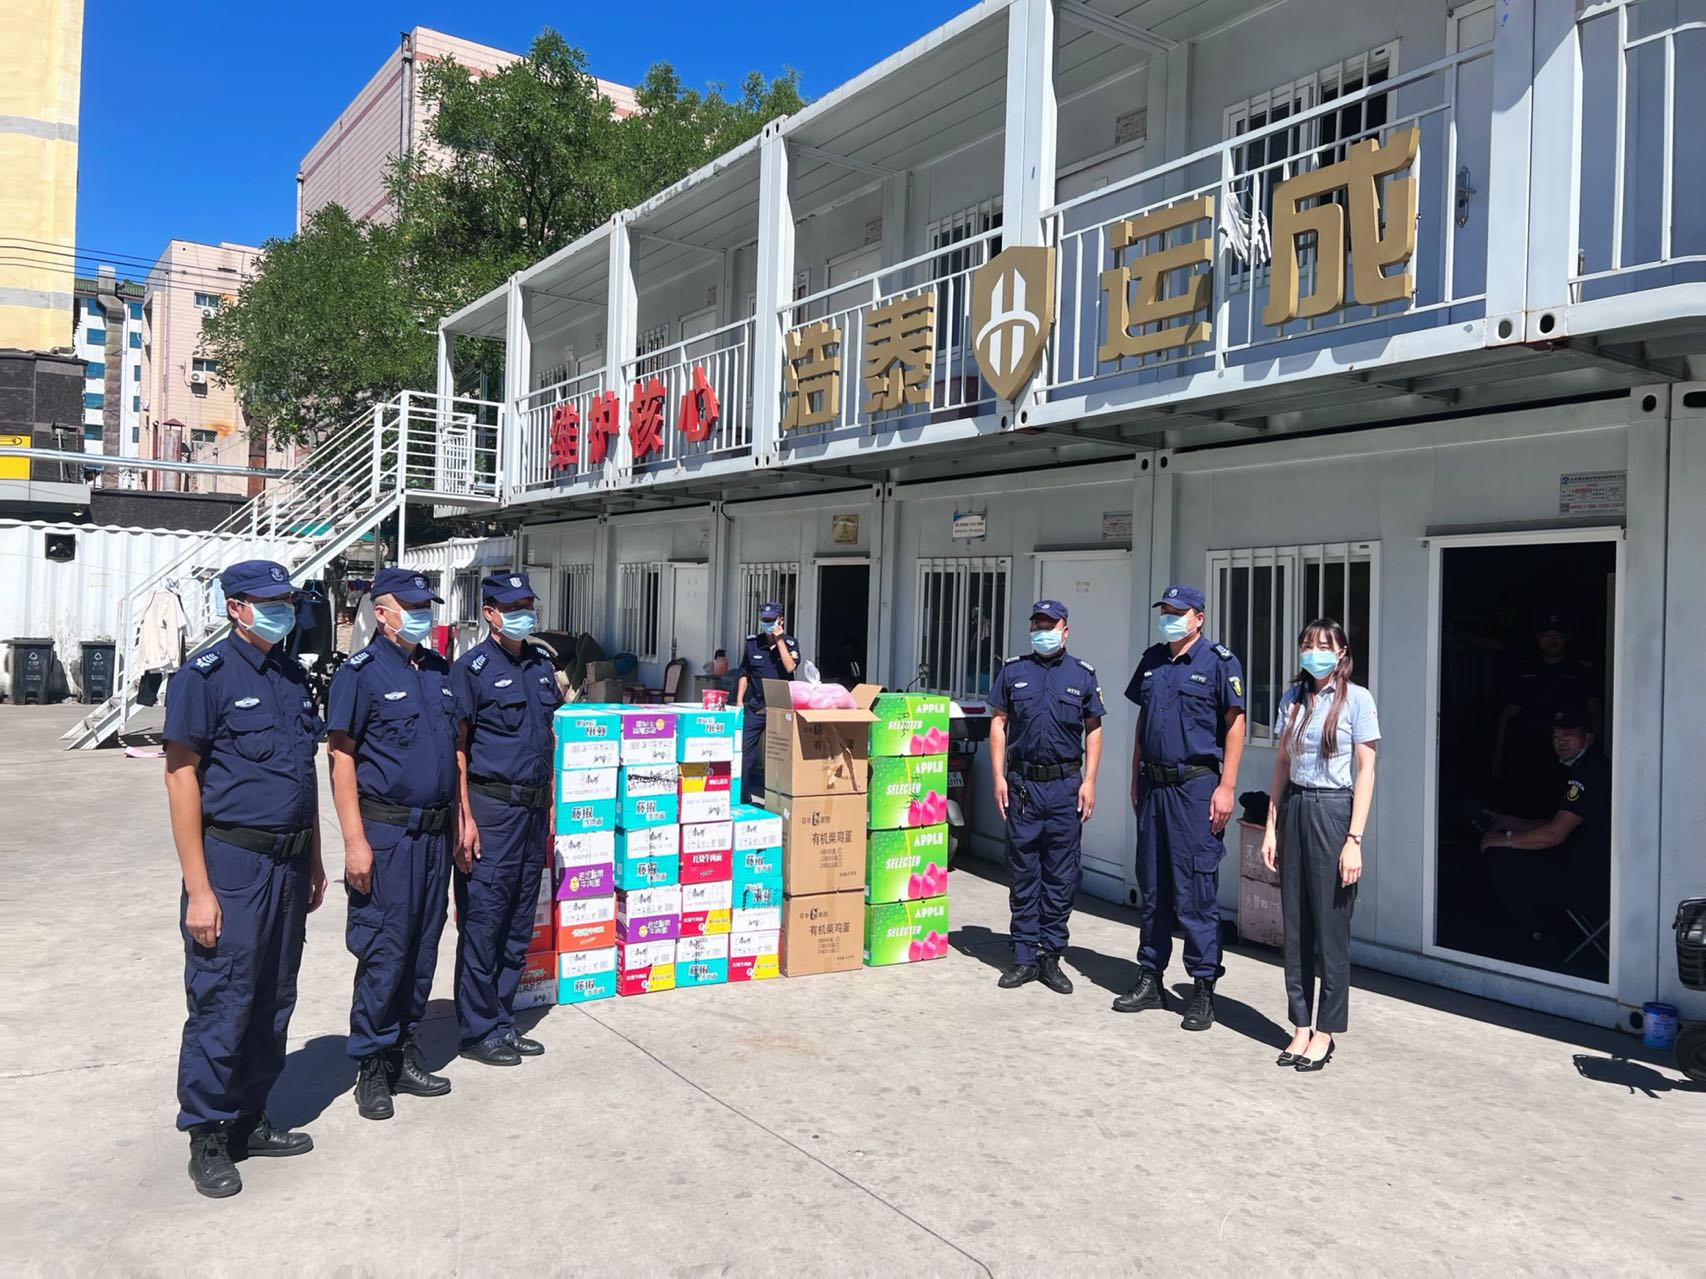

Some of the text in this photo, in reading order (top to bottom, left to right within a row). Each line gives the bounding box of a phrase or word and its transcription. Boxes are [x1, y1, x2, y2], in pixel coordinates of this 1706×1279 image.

[782, 127, 1422, 431] 浩泰 运成
[549, 365, 720, 471] 维护核心
[915, 704, 945, 713] APPLE
[887, 721, 922, 730] SELECTED
[914, 761, 943, 774] APPLE
[886, 783, 921, 795] SELECTED
[812, 830, 853, 846] 有机柴鸡蛋
[914, 832, 943, 846] APPLE
[886, 856, 921, 869] SELECTED
[914, 906, 944, 919] APPLE
[810, 922, 850, 936] 有机柴鸡蛋
[886, 925, 922, 937] SELECTED
